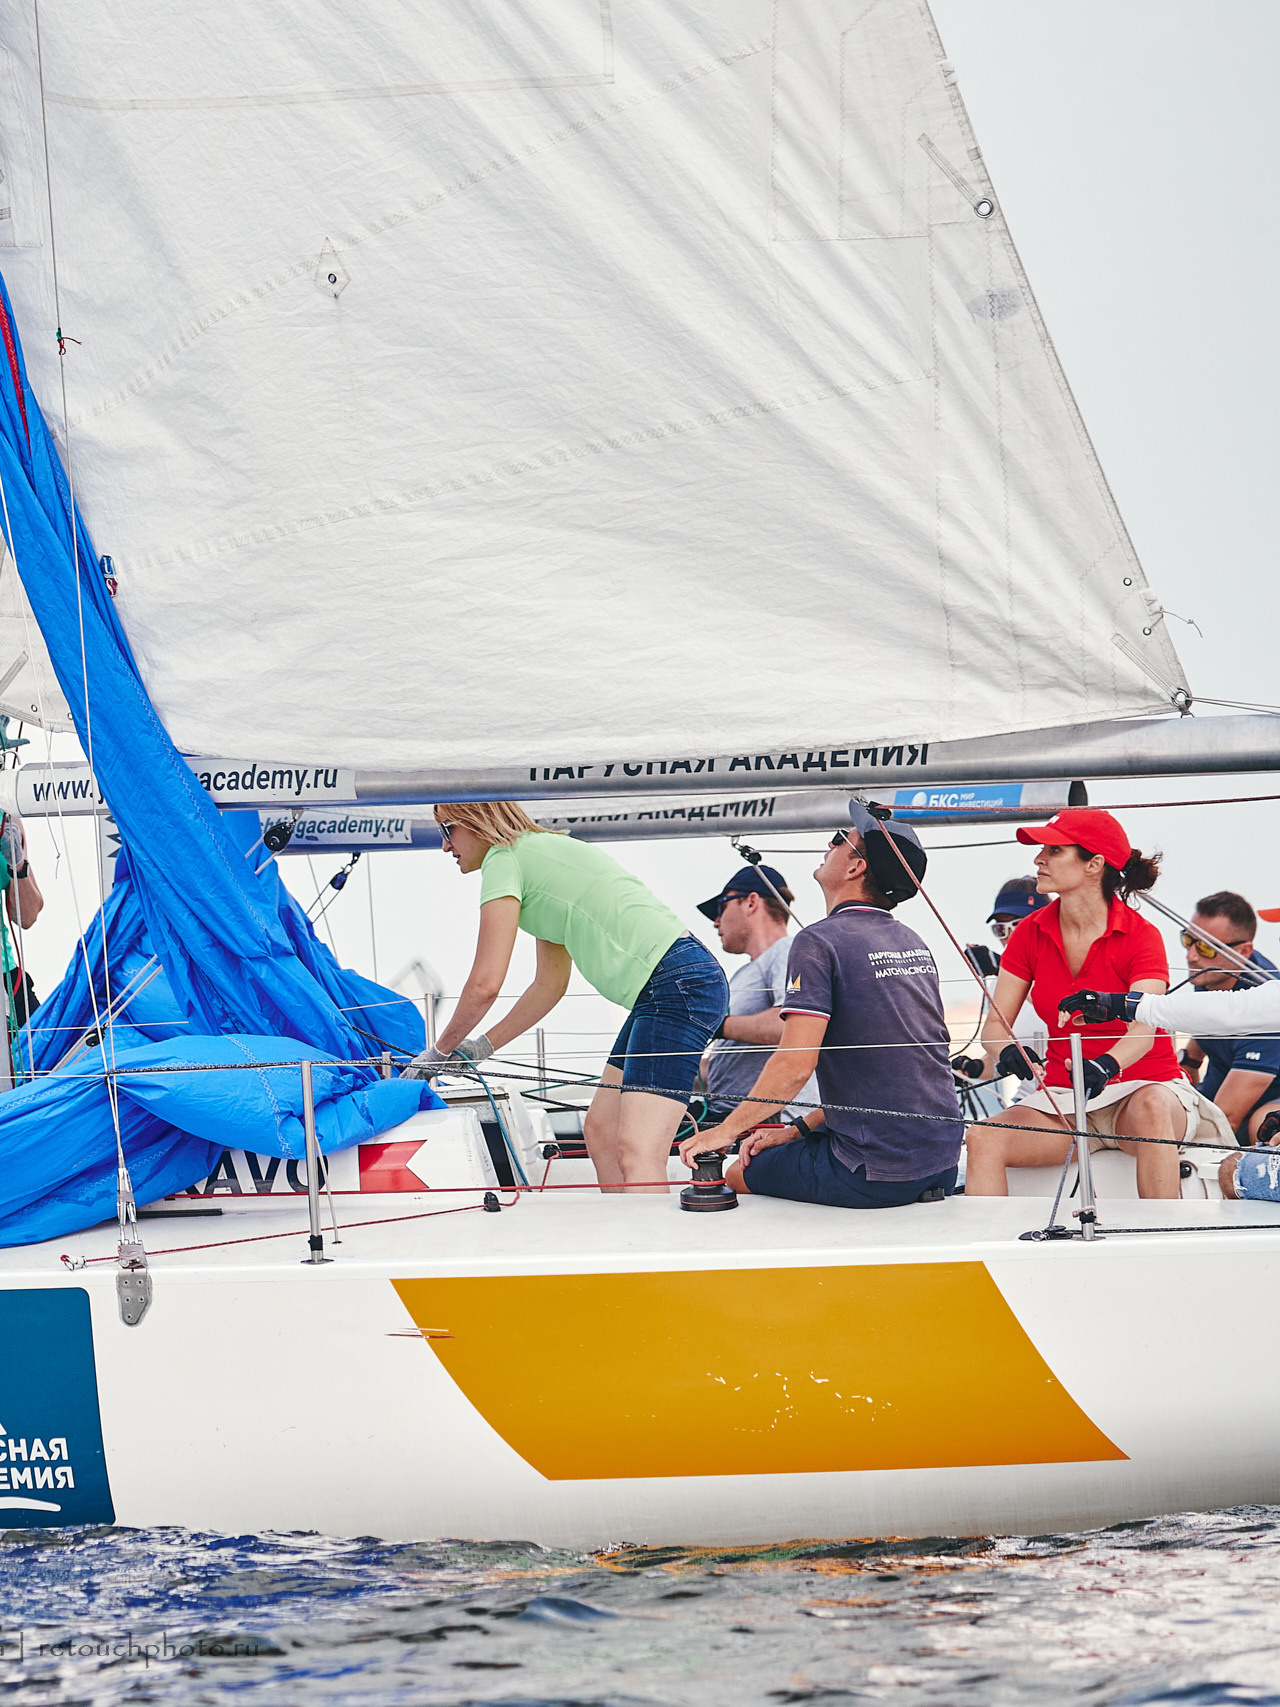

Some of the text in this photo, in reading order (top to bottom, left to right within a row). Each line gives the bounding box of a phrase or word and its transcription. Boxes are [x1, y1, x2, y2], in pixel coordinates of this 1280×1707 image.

[728, 743, 929, 772] АКАДЕМИЯ
[195, 763, 338, 796] academy.ru
[928, 793, 959, 808] БКС
[875, 967, 903, 979] MATCH
[178, 1149, 329, 1199] AVO
